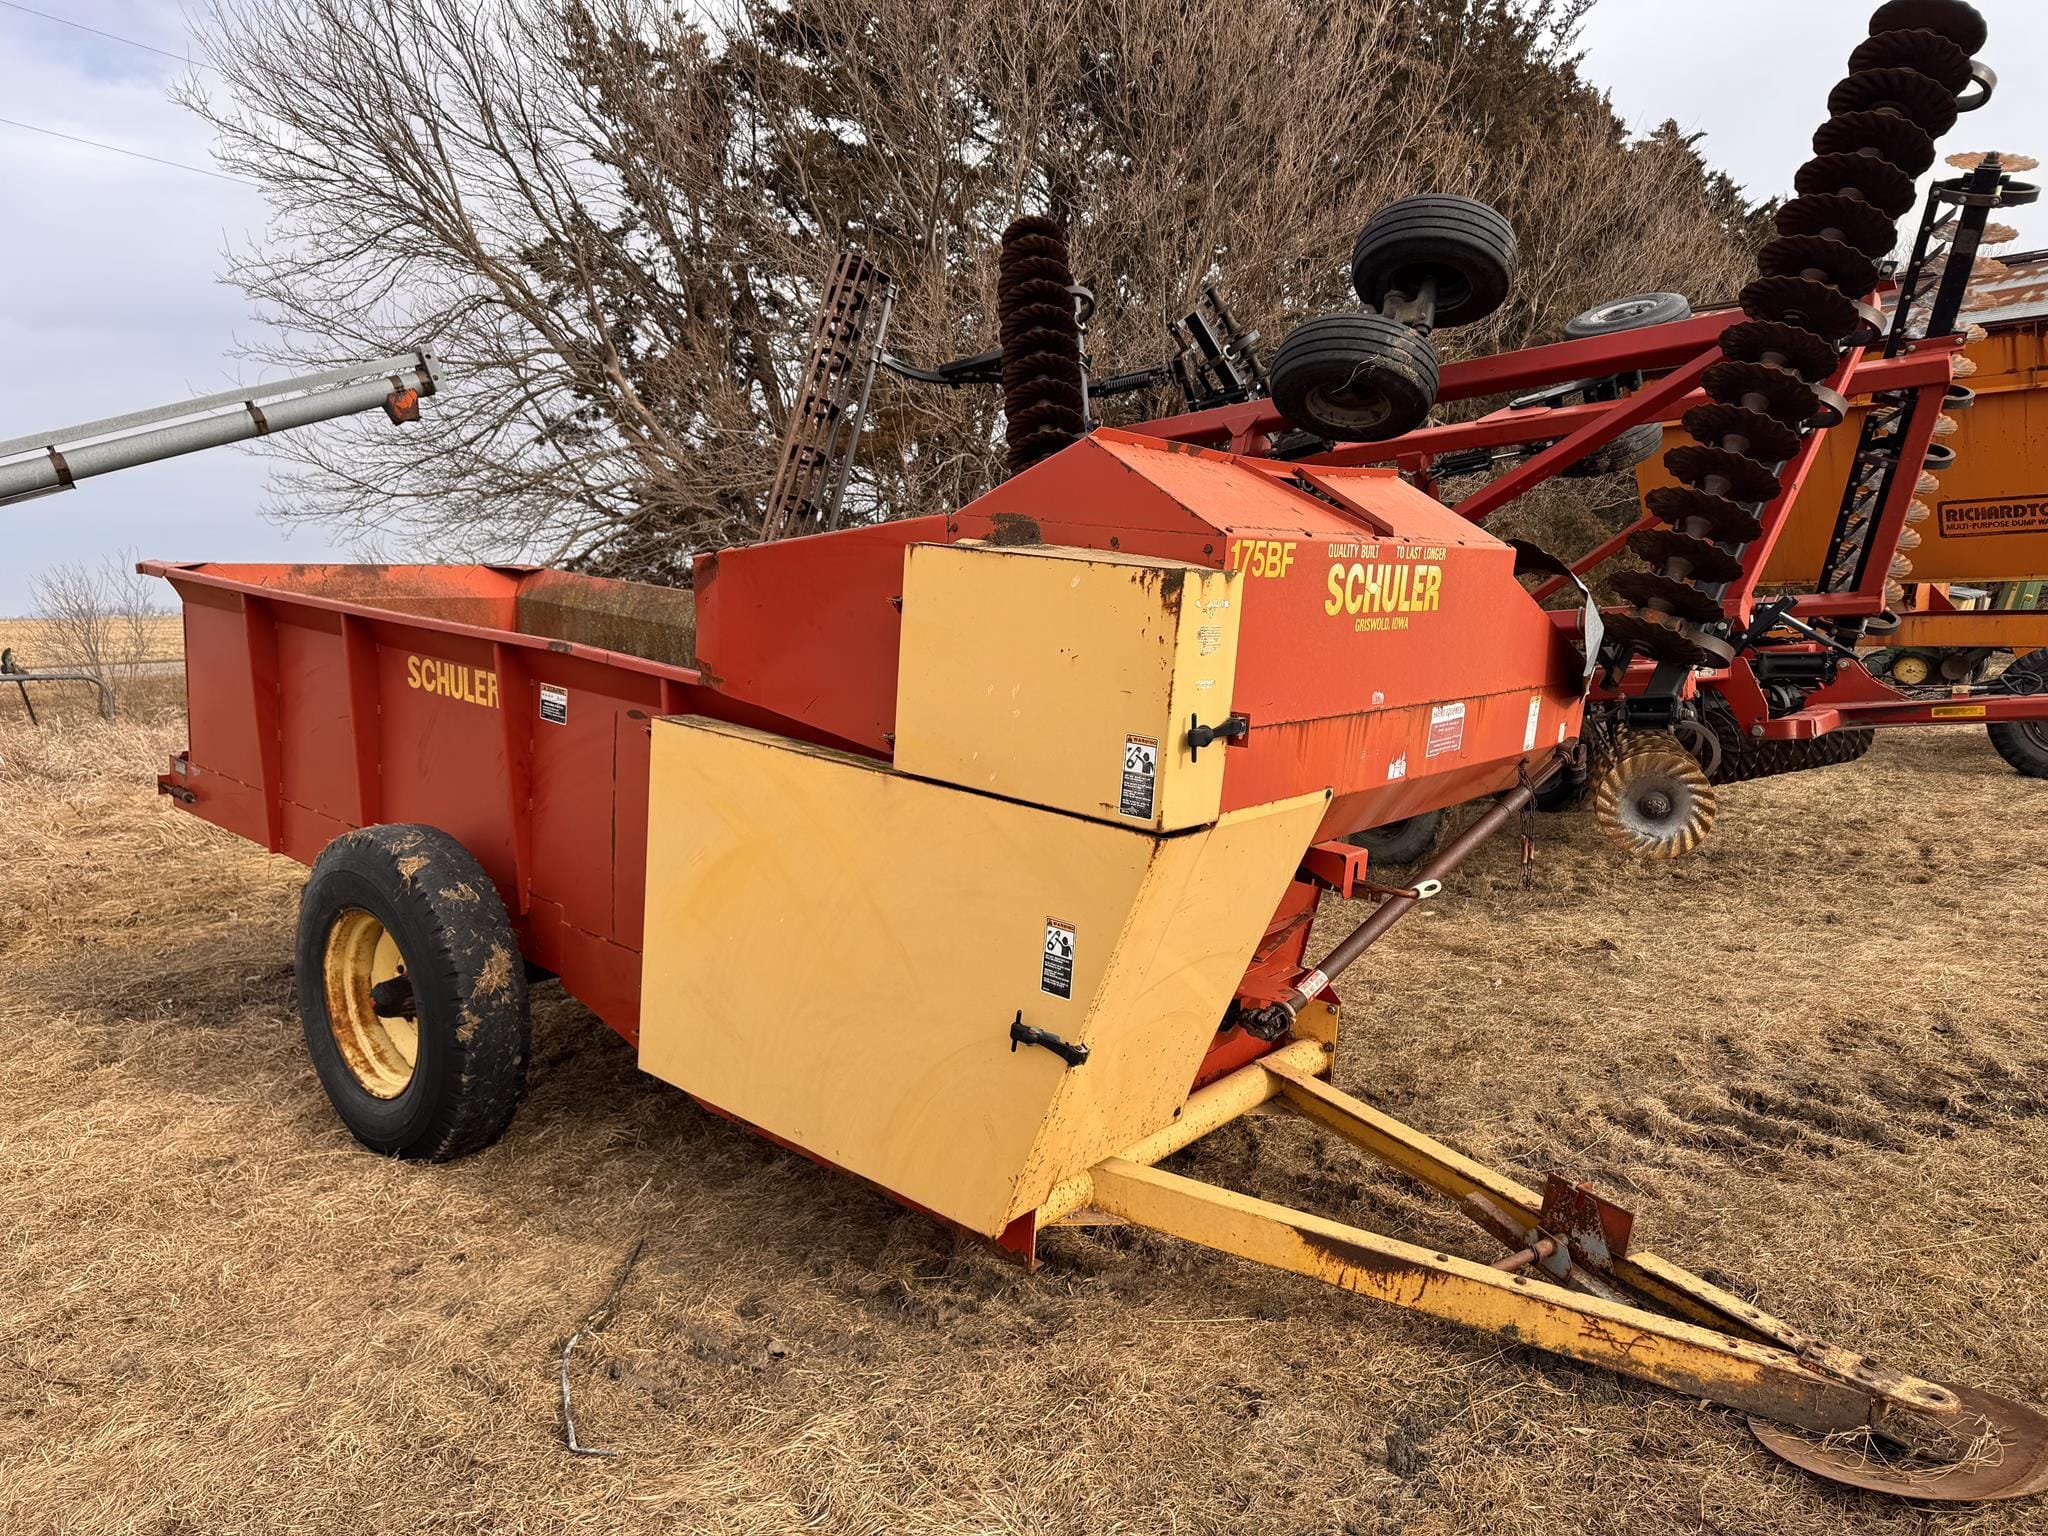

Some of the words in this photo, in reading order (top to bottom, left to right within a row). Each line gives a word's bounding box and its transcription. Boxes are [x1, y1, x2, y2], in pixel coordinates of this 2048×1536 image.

[1946, 520, 2010, 530] MULTI-PURPOSE
[2011, 519, 2037, 527] DUMP
[1230, 539, 1297, 578] 175BF
[1328, 543, 1359, 558] QUALITY
[1361, 544, 1381, 559] BUILT
[1396, 545, 1405, 560] TO
[1406, 546, 1422, 560] LAST
[1423, 547, 1447, 561] LONGER
[1324, 563, 1442, 616] SCHULER
[1355, 617, 1391, 633] GRISWOLD,
[1391, 616, 1409, 630] IOWA
[407, 655, 500, 709] SCHULER
[1133, 737, 1157, 746] WARNING
[1053, 921, 1075, 931] WARNING
